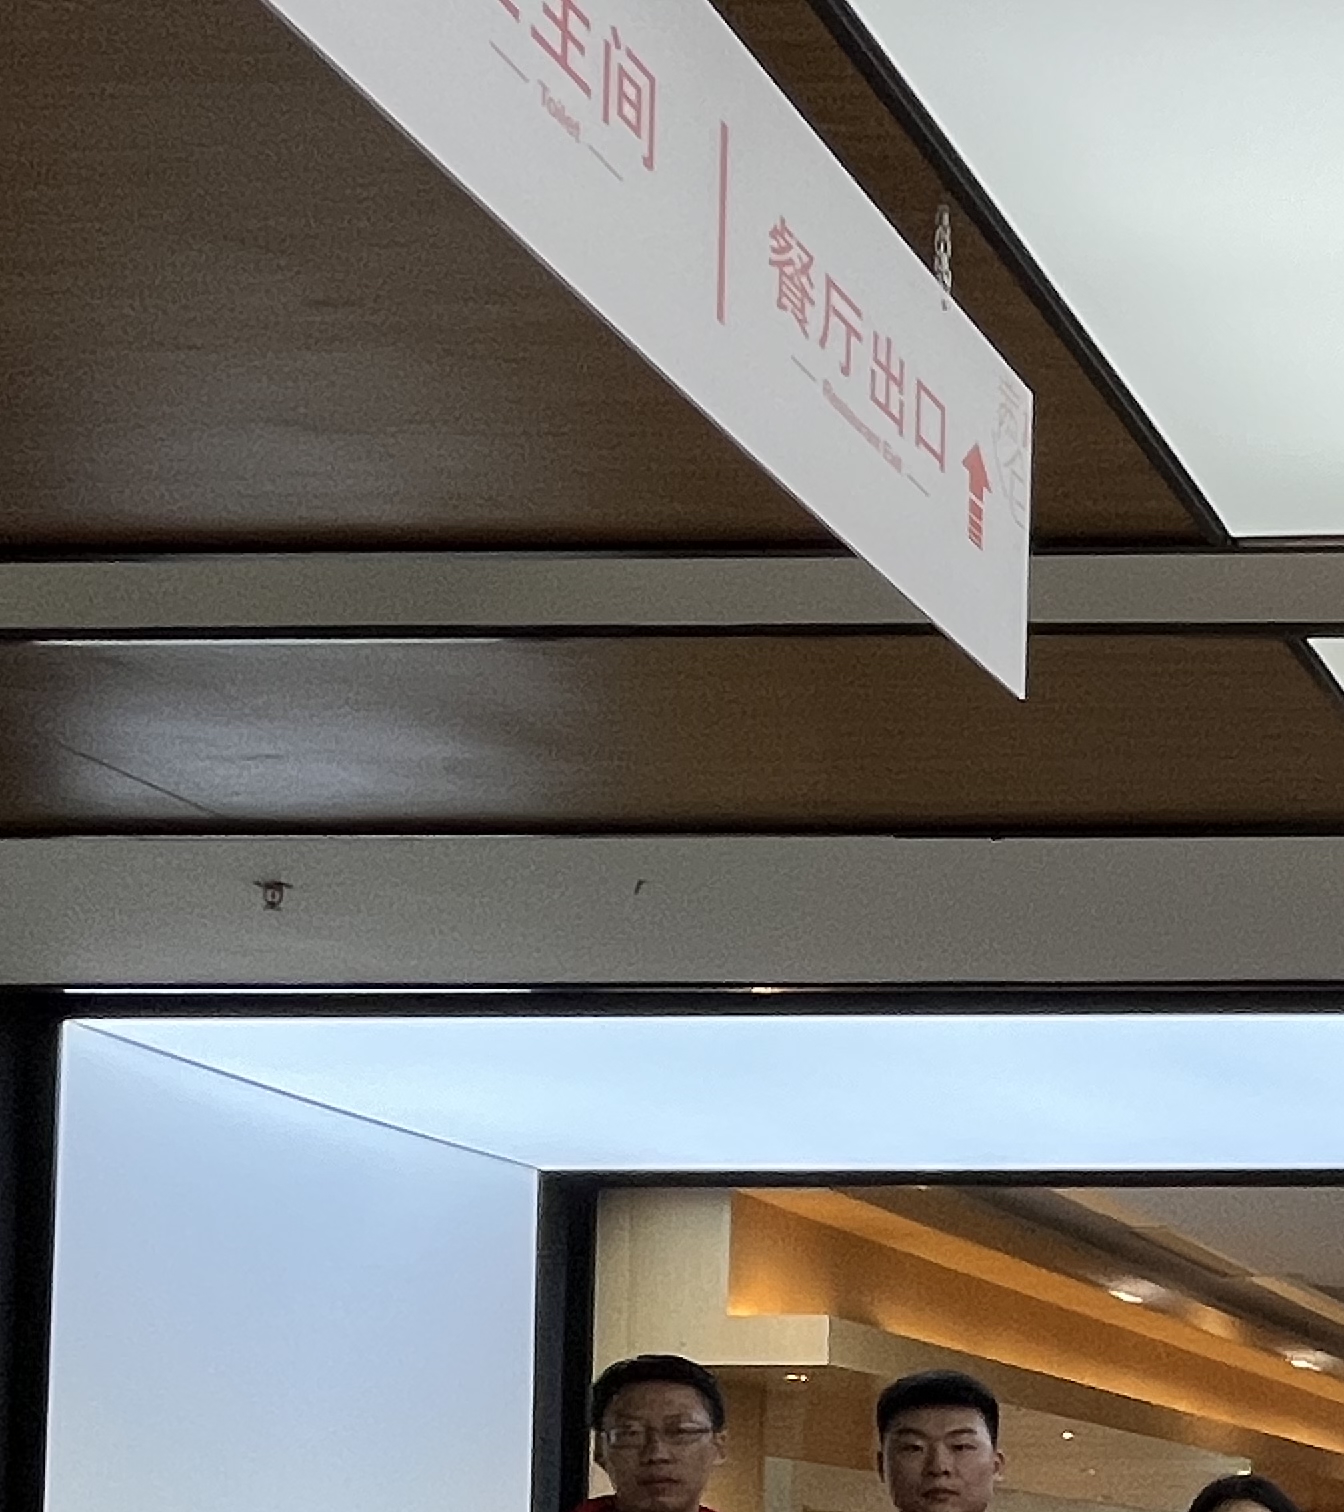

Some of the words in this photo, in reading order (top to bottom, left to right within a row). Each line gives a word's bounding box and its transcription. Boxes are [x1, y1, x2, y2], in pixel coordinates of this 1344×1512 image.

[499, 0, 655, 171] 生间
[769, 215, 946, 473] 餐厅出口
